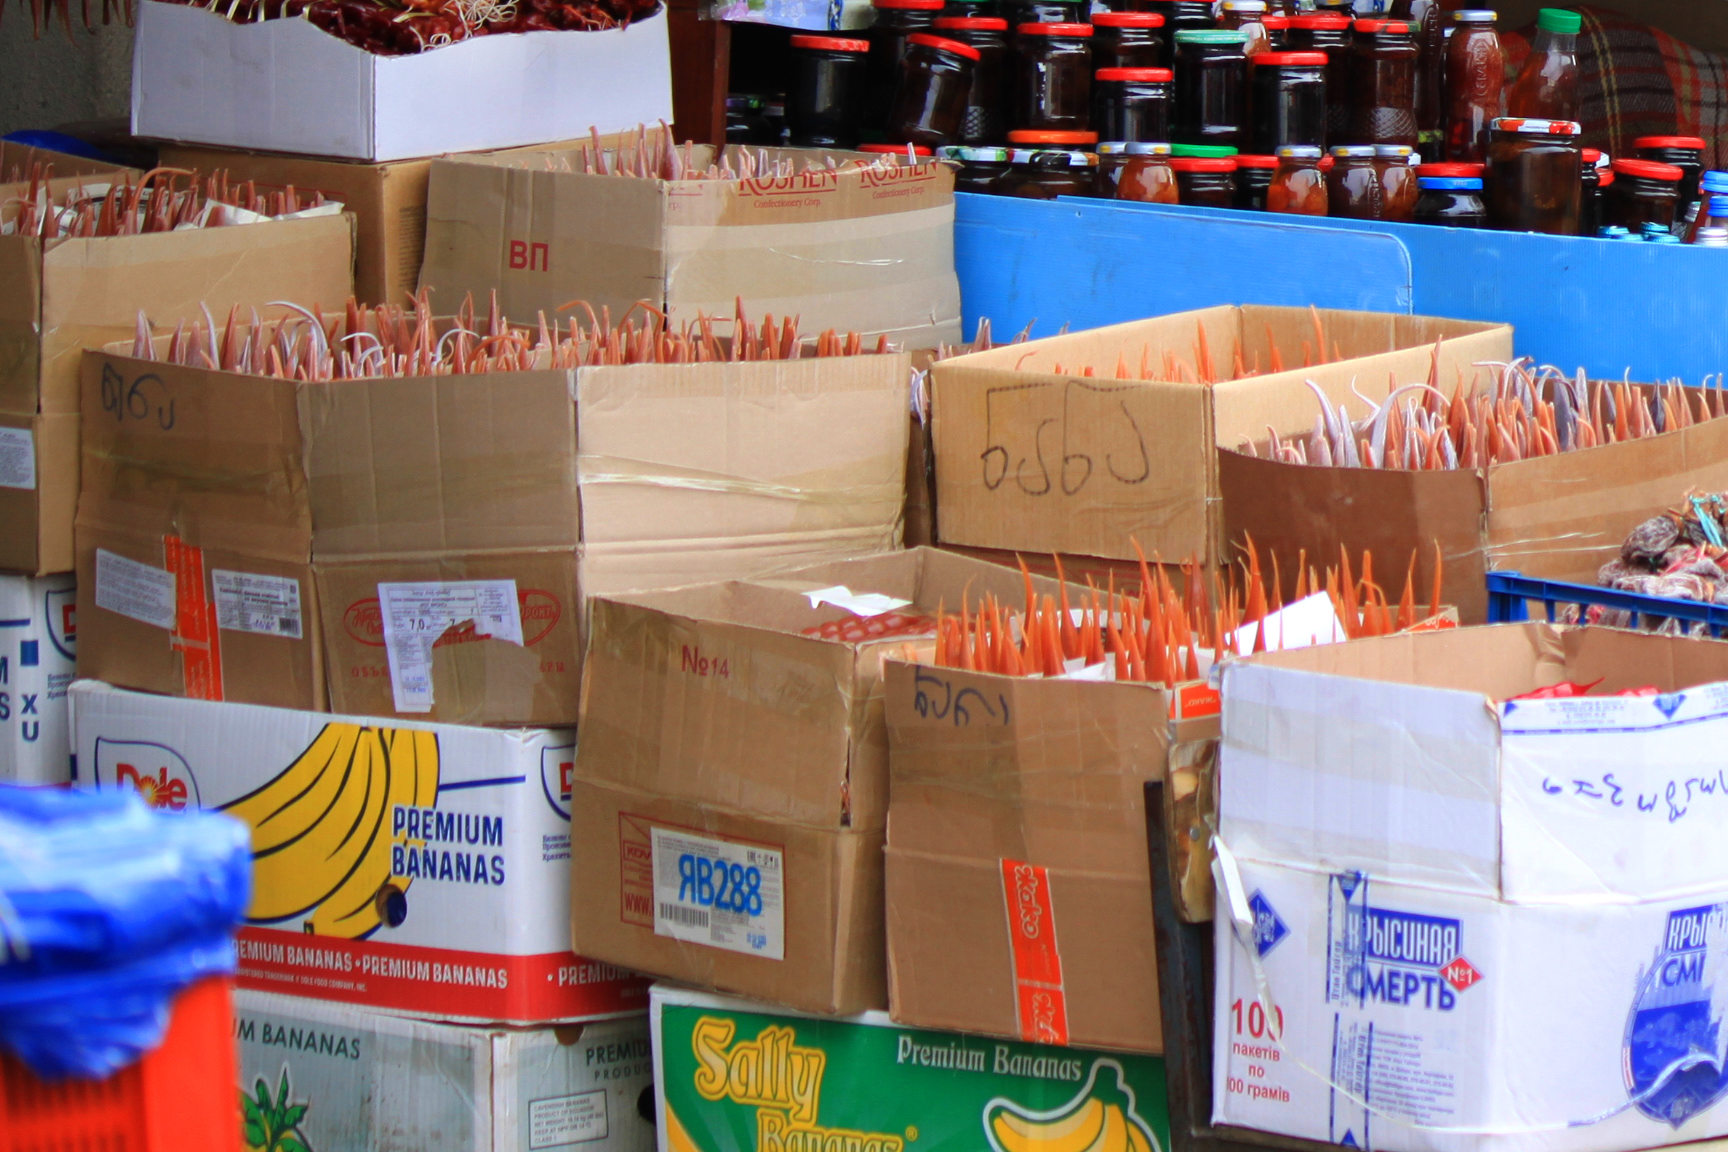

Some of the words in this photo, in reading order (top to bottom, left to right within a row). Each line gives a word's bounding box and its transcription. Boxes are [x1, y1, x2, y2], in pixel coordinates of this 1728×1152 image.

[509, 239, 549, 273] ВП
[116, 763, 189, 812] Dole
[391, 805, 505, 846] PREMIUM
[391, 844, 506, 886] BANANAS
[287, 946, 353, 973] BANANAS
[362, 955, 430, 983] PREMIUM
[433, 964, 508, 989] BANANAS
[262, 1026, 361, 1060] BANANAS
[897, 1034, 986, 1072] Premium
[993, 1044, 1082, 1081] Bananas
[1233, 1041, 1281, 1062] пакетів
[692, 1016, 827, 1123] Sally
[1248, 1063, 1265, 1078] по
[1247, 1082, 1291, 1104] грамів
